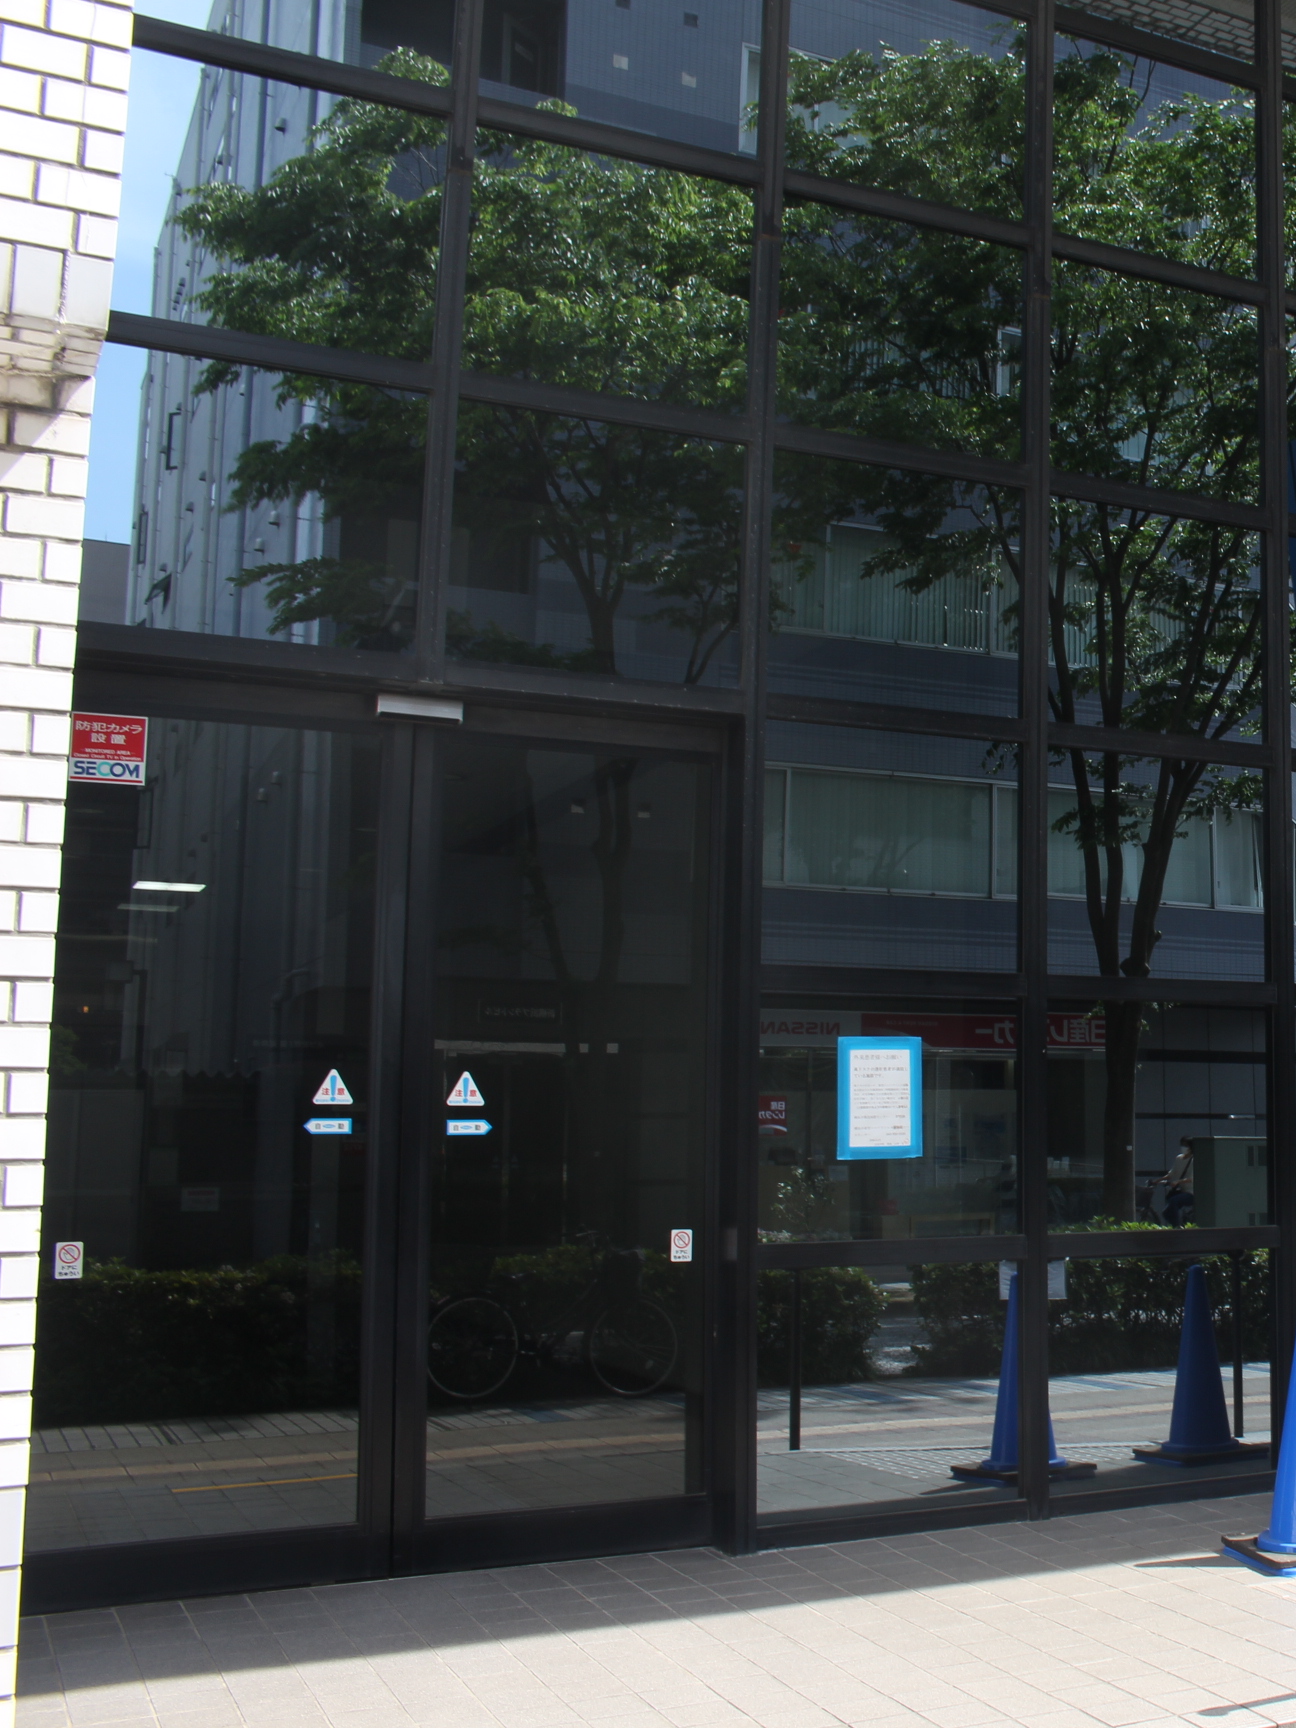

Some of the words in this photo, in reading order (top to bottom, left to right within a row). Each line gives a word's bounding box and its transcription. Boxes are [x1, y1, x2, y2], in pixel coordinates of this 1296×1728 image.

[75, 720, 143, 735] 防犯カメラ
[91, 733, 127, 746] 設置
[73, 760, 140, 778] SECOM
